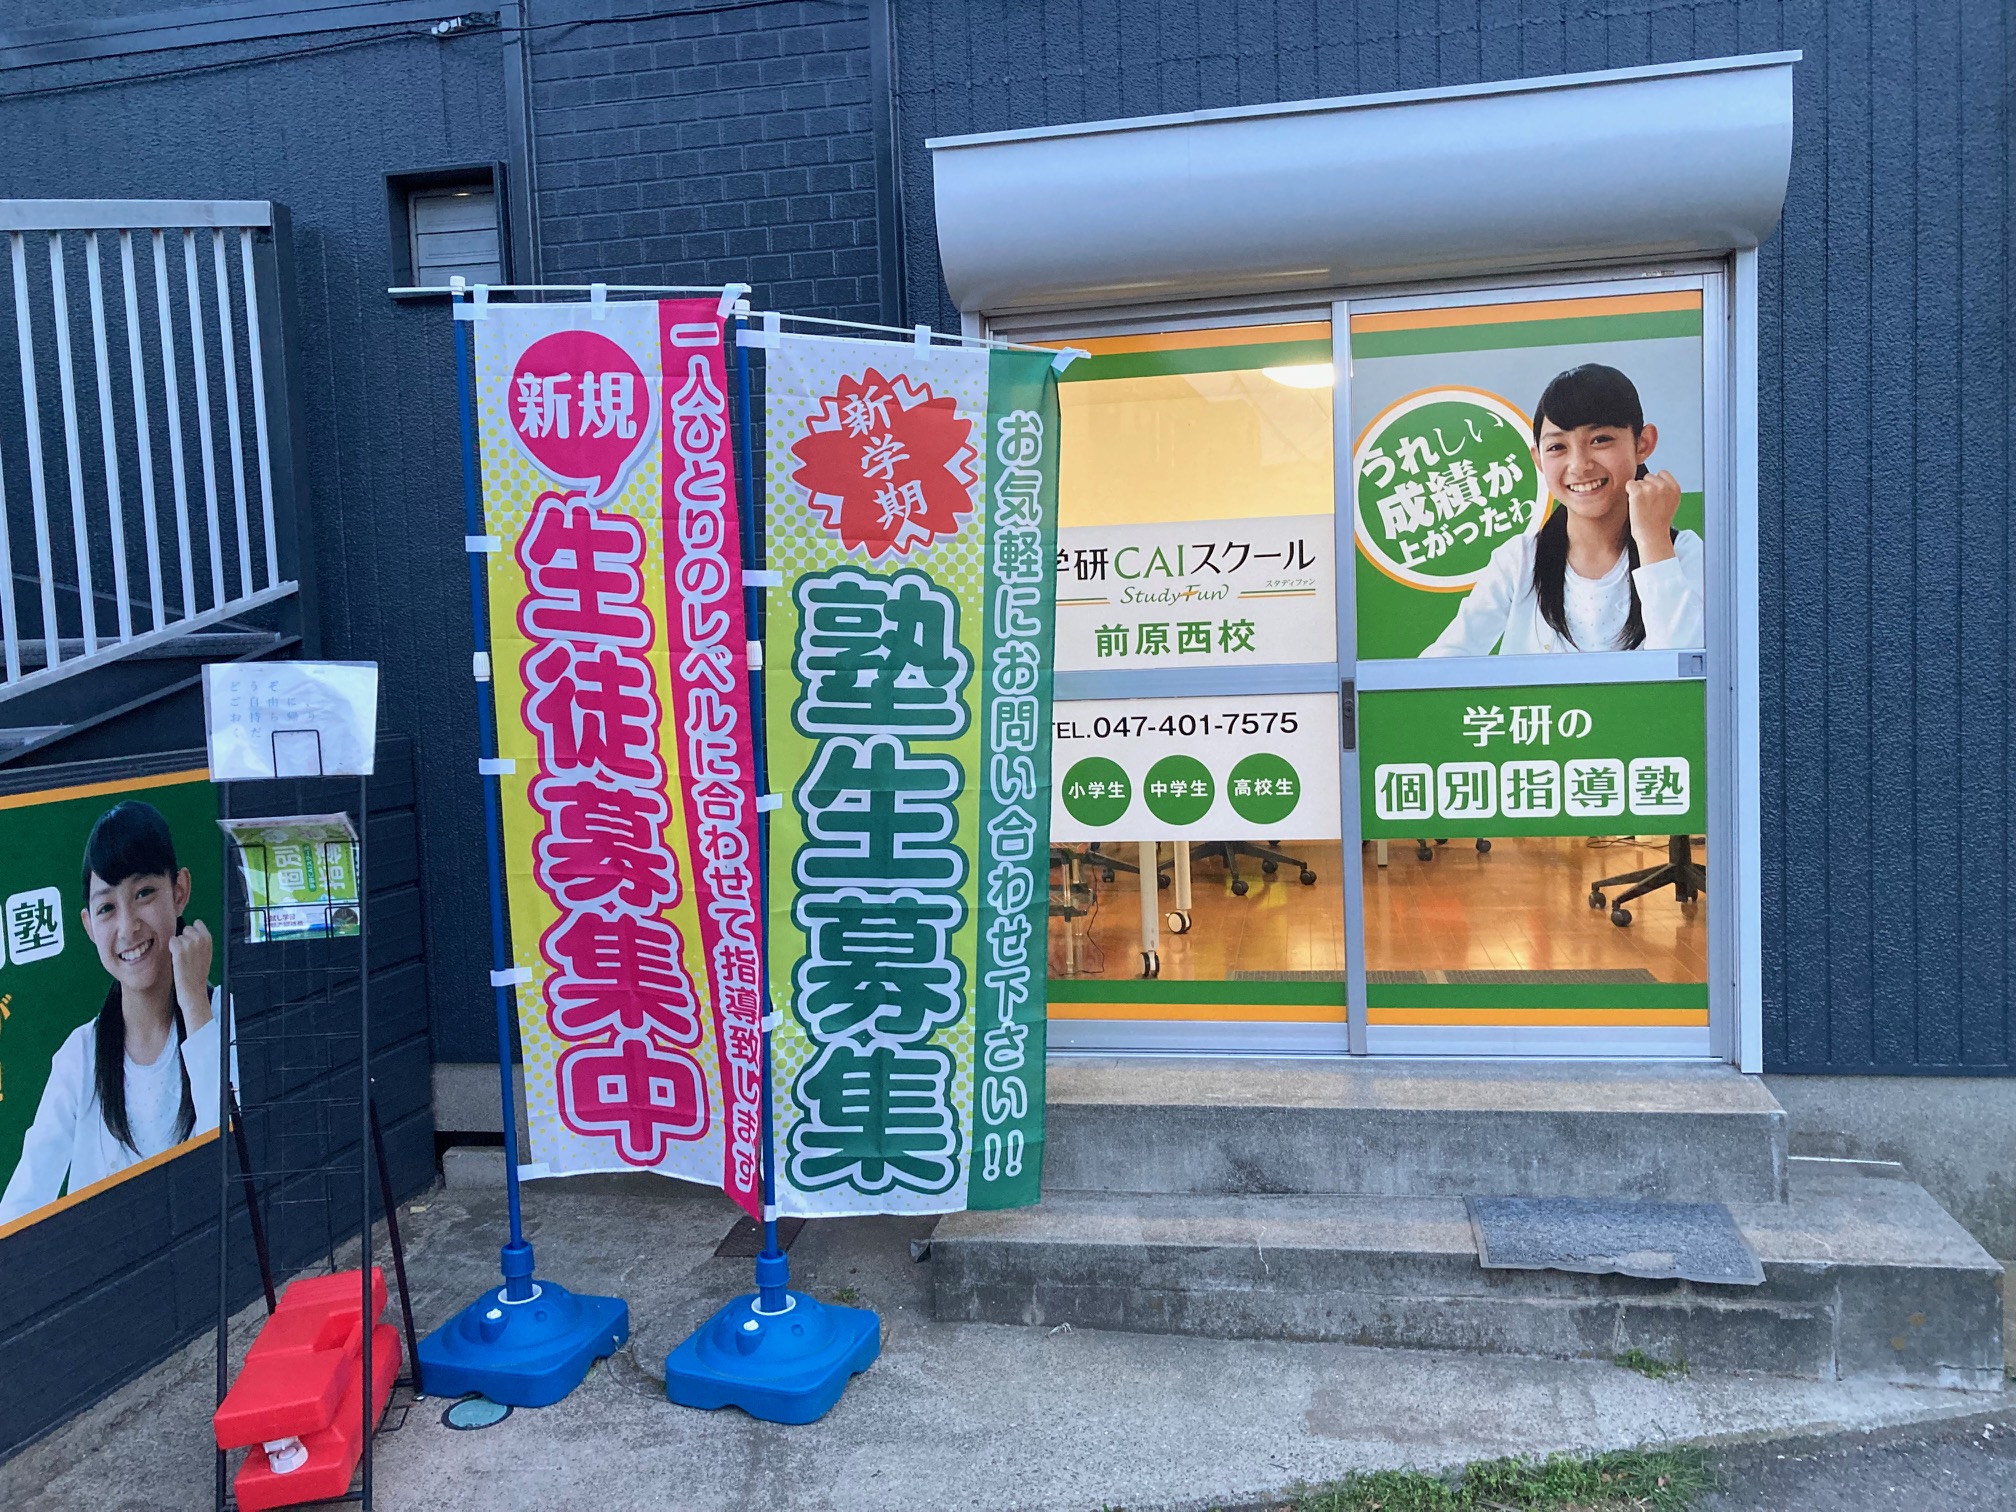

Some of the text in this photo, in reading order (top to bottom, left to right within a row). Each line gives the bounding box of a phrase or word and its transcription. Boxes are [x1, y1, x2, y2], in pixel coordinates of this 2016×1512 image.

[517, 371, 637, 439] 新規
[841, 385, 928, 531] 新学期
[1361, 411, 1504, 488] うれしい
[1376, 453, 1523, 540] 成績が
[1398, 500, 1536, 571] 上がったわ
[1266, 578, 1316, 588] スタディファン
[1094, 618, 1256, 658] 前原西校
[230, 680, 280, 692] どうぞ
[1052, 712, 1298, 740] EL.047-401-7575
[1462, 705, 1593, 748] 学研の
[1068, 777, 1294, 799] 小学生 中学生 高校生
[1380, 764, 1685, 814] 個別指導塾
[515, 492, 711, 1166] 生徒募集中
[786, 567, 974, 1193] 塾生募集
[12, 897, 59, 954] 塾
